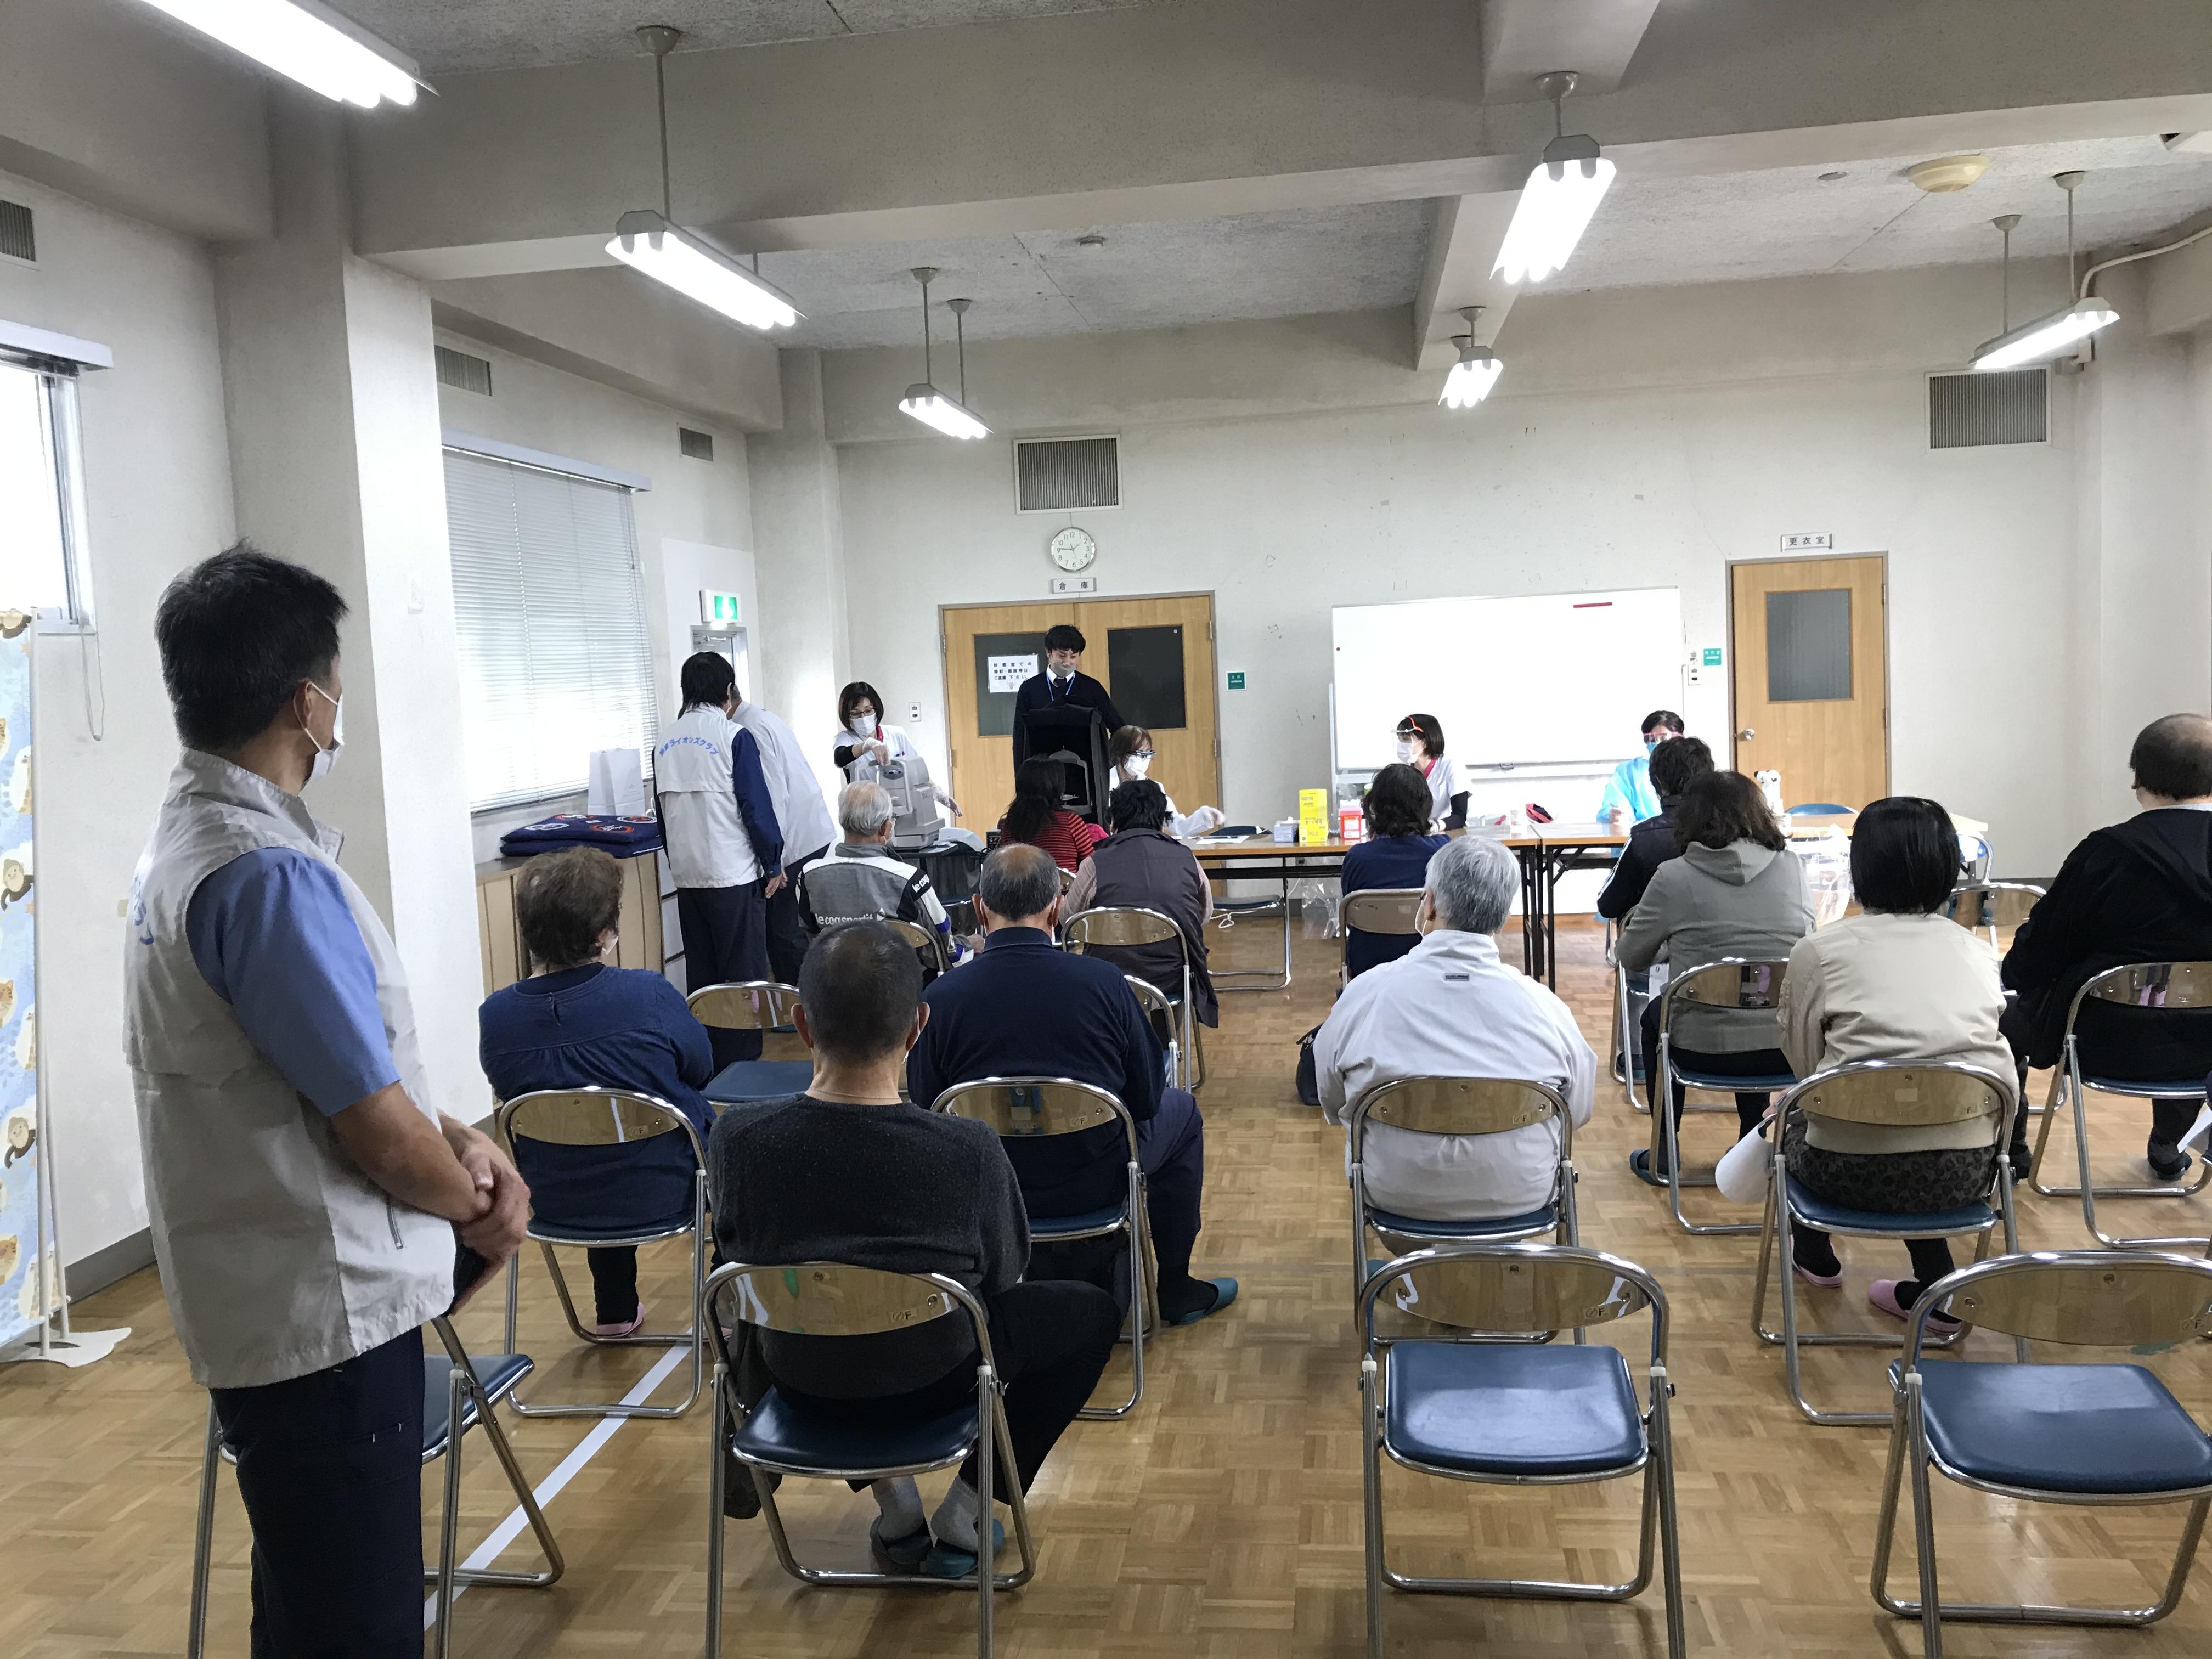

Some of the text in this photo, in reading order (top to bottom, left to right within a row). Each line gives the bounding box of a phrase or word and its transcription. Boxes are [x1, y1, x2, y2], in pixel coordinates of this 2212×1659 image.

[1789, 535, 1825, 546] 更衣室
[912, 884, 921, 893] le
[814, 913, 824, 925] le
